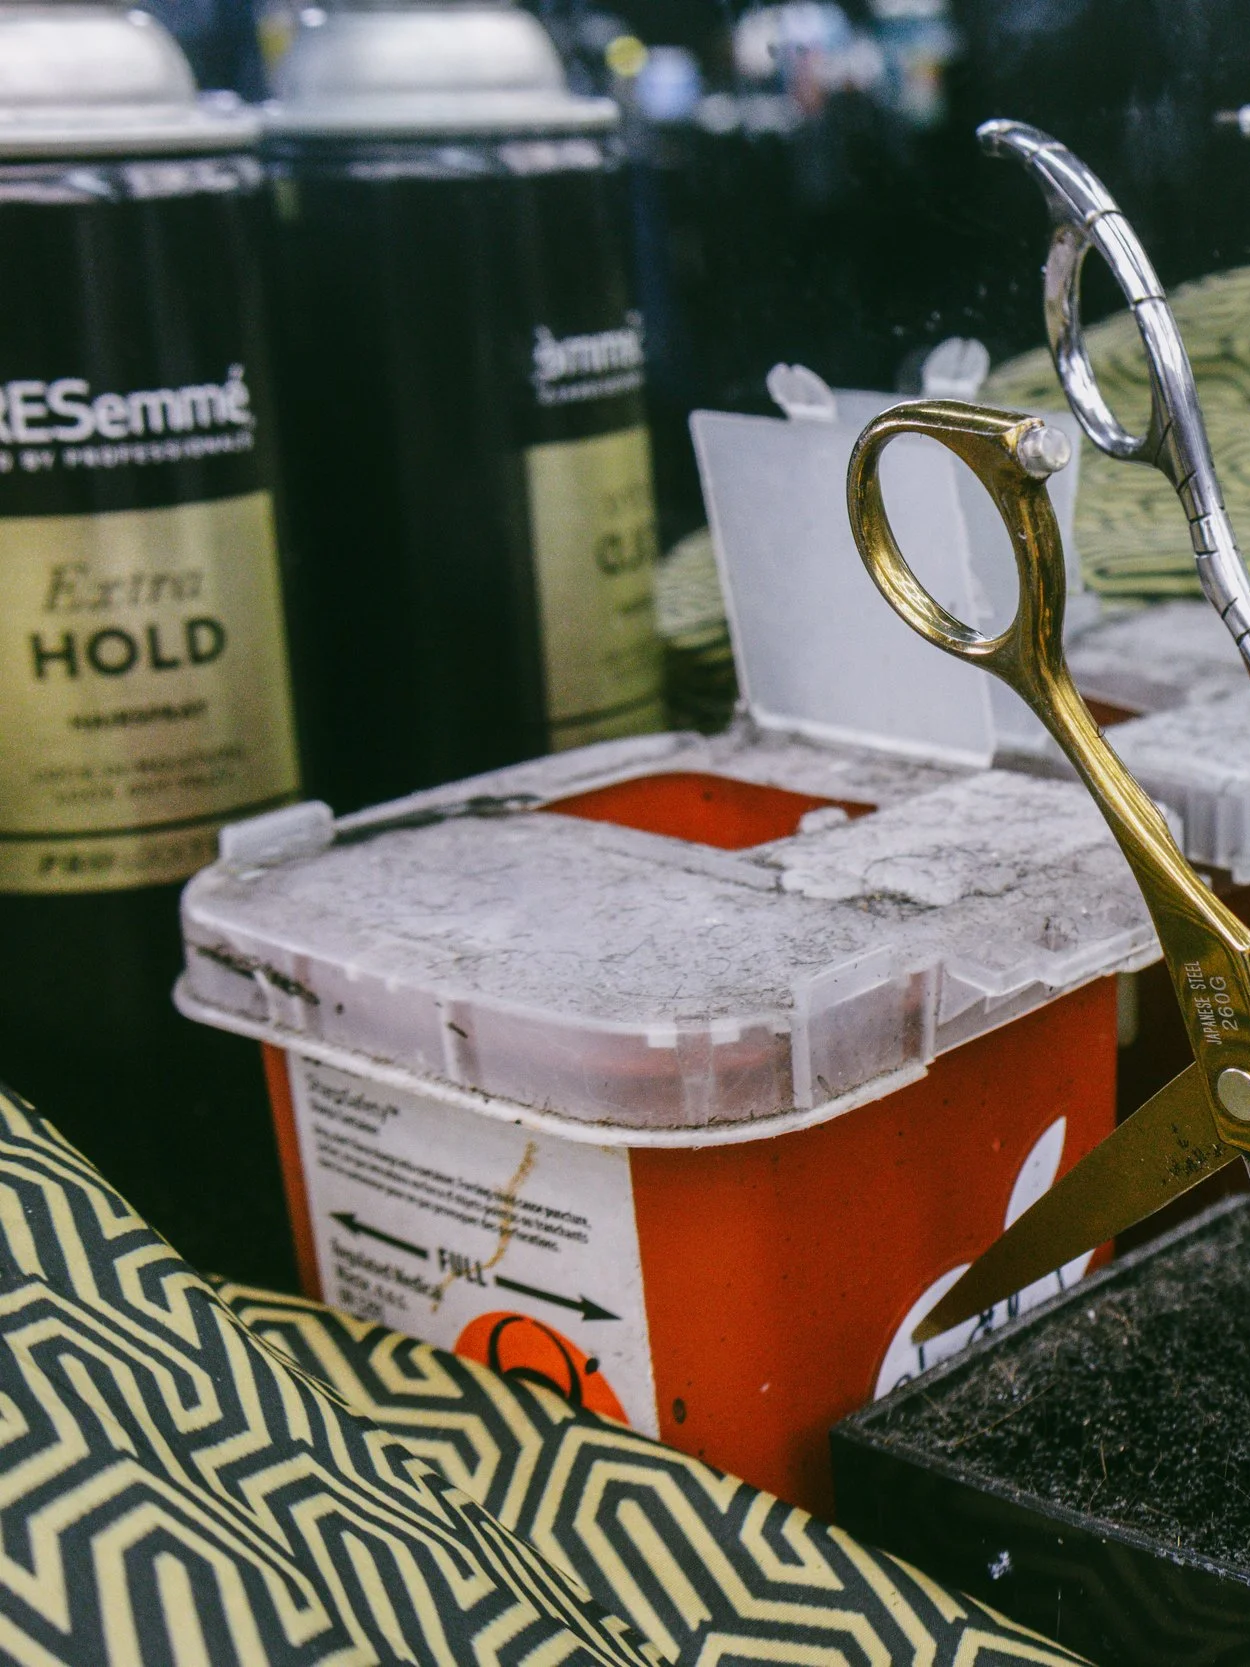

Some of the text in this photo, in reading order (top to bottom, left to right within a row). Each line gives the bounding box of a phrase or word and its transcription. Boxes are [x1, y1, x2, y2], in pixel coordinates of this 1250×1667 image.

[0, 364, 250, 443] ESemmé
[29, 617, 226, 680] HOLD
[1184, 960, 1223, 1045] JAPANESE STEEL
[1209, 976, 1239, 1031] 260G
[437, 1248, 487, 1288] FULL
